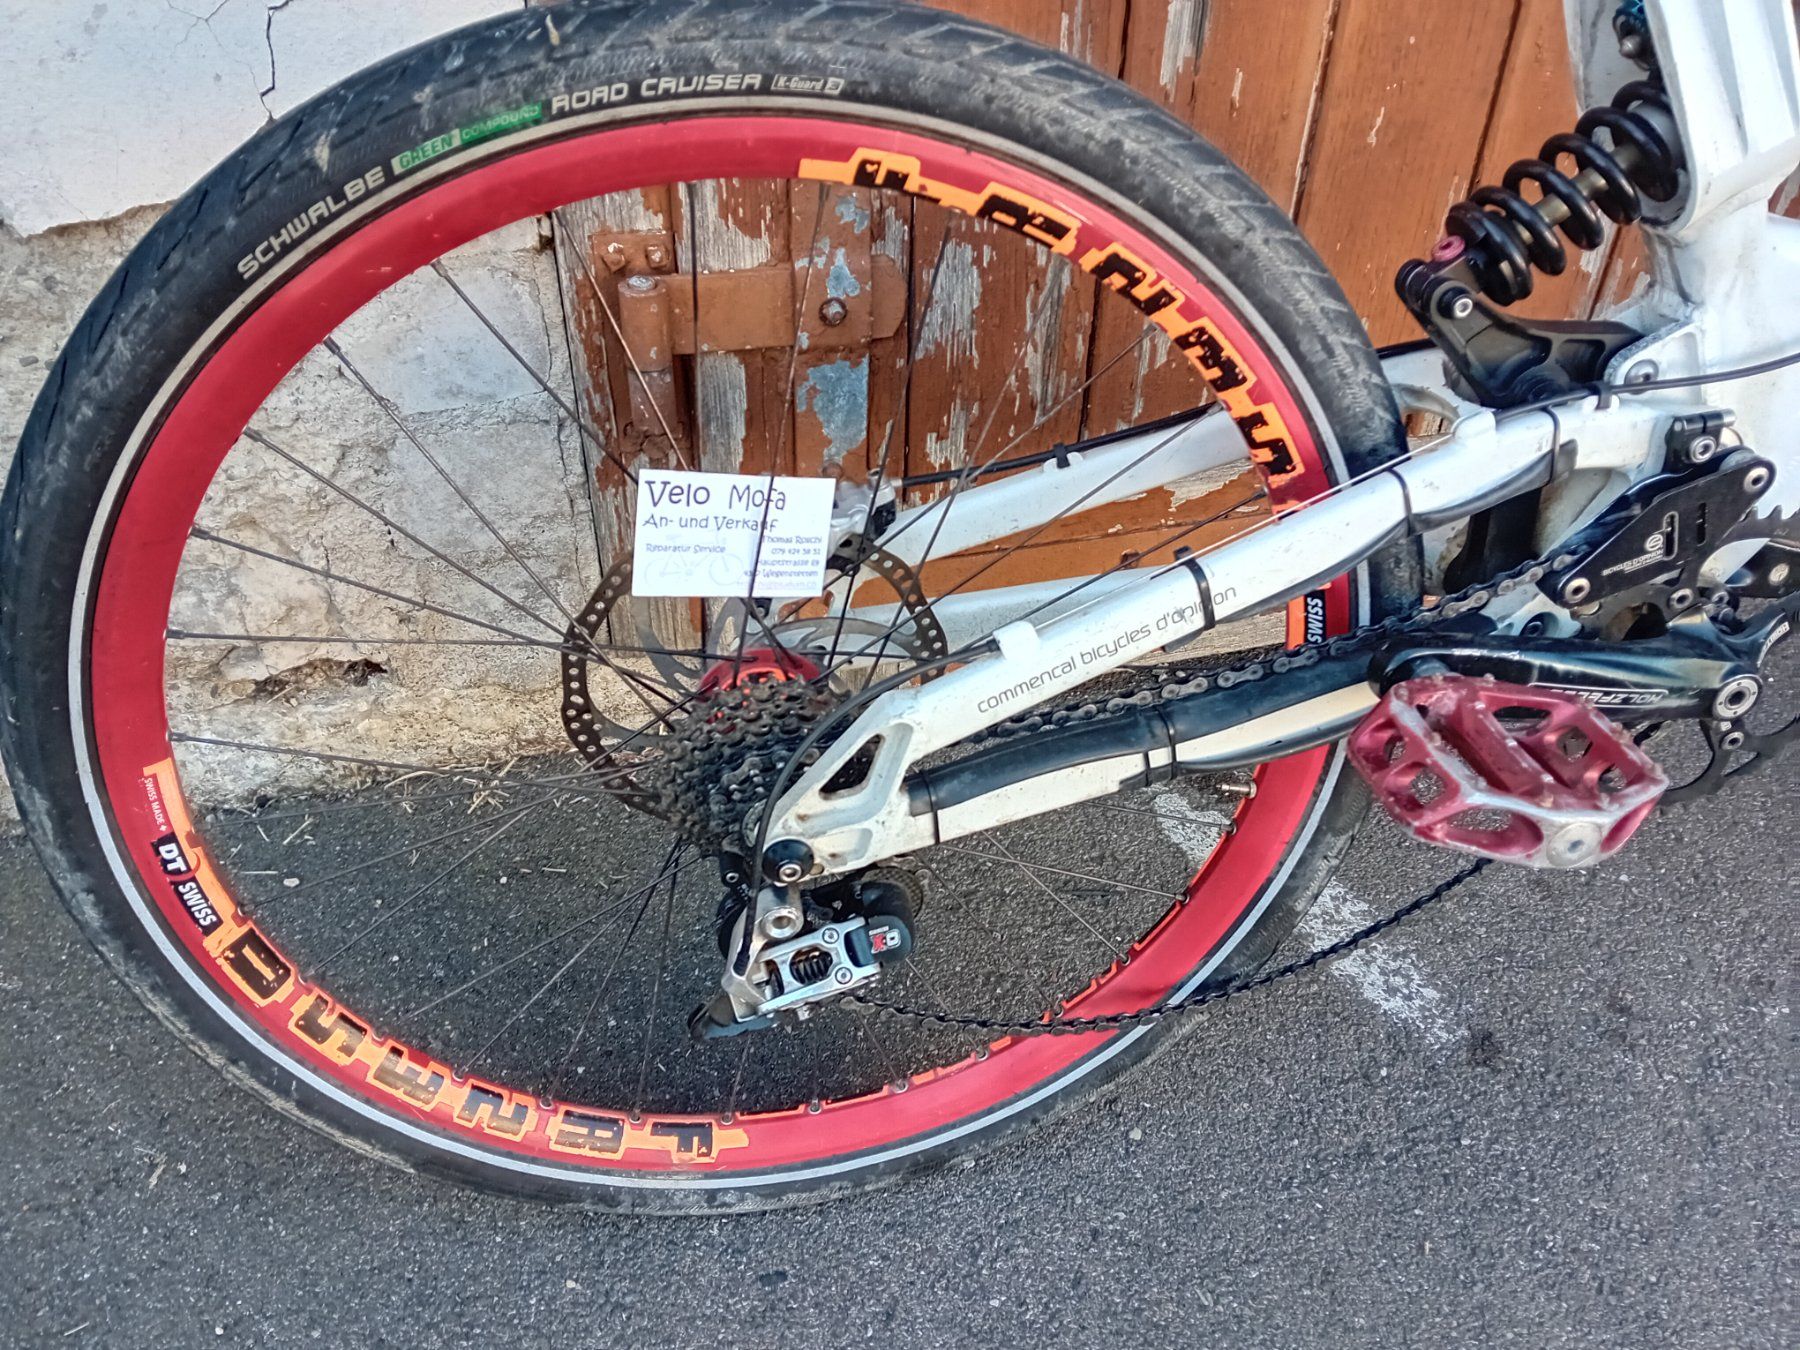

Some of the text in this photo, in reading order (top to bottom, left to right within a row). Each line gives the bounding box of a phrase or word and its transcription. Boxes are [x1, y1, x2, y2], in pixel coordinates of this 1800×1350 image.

[551, 83, 629, 116] ROAD
[641, 73, 763, 98] CRUISER
[399, 104, 540, 169] GREEN COMPOUND
[237, 164, 385, 280] SCHWALBE
[642, 513, 674, 530] An-
[679, 514, 709, 530] und
[644, 480, 786, 512] Velo Mofa
[1306, 597, 1324, 644] SWISS
[977, 655, 1076, 714] commencal
[1081, 627, 1152, 666] bicycles
[144, 776, 165, 828] SWISS MADE
[158, 842, 217, 927] DT SWISS
